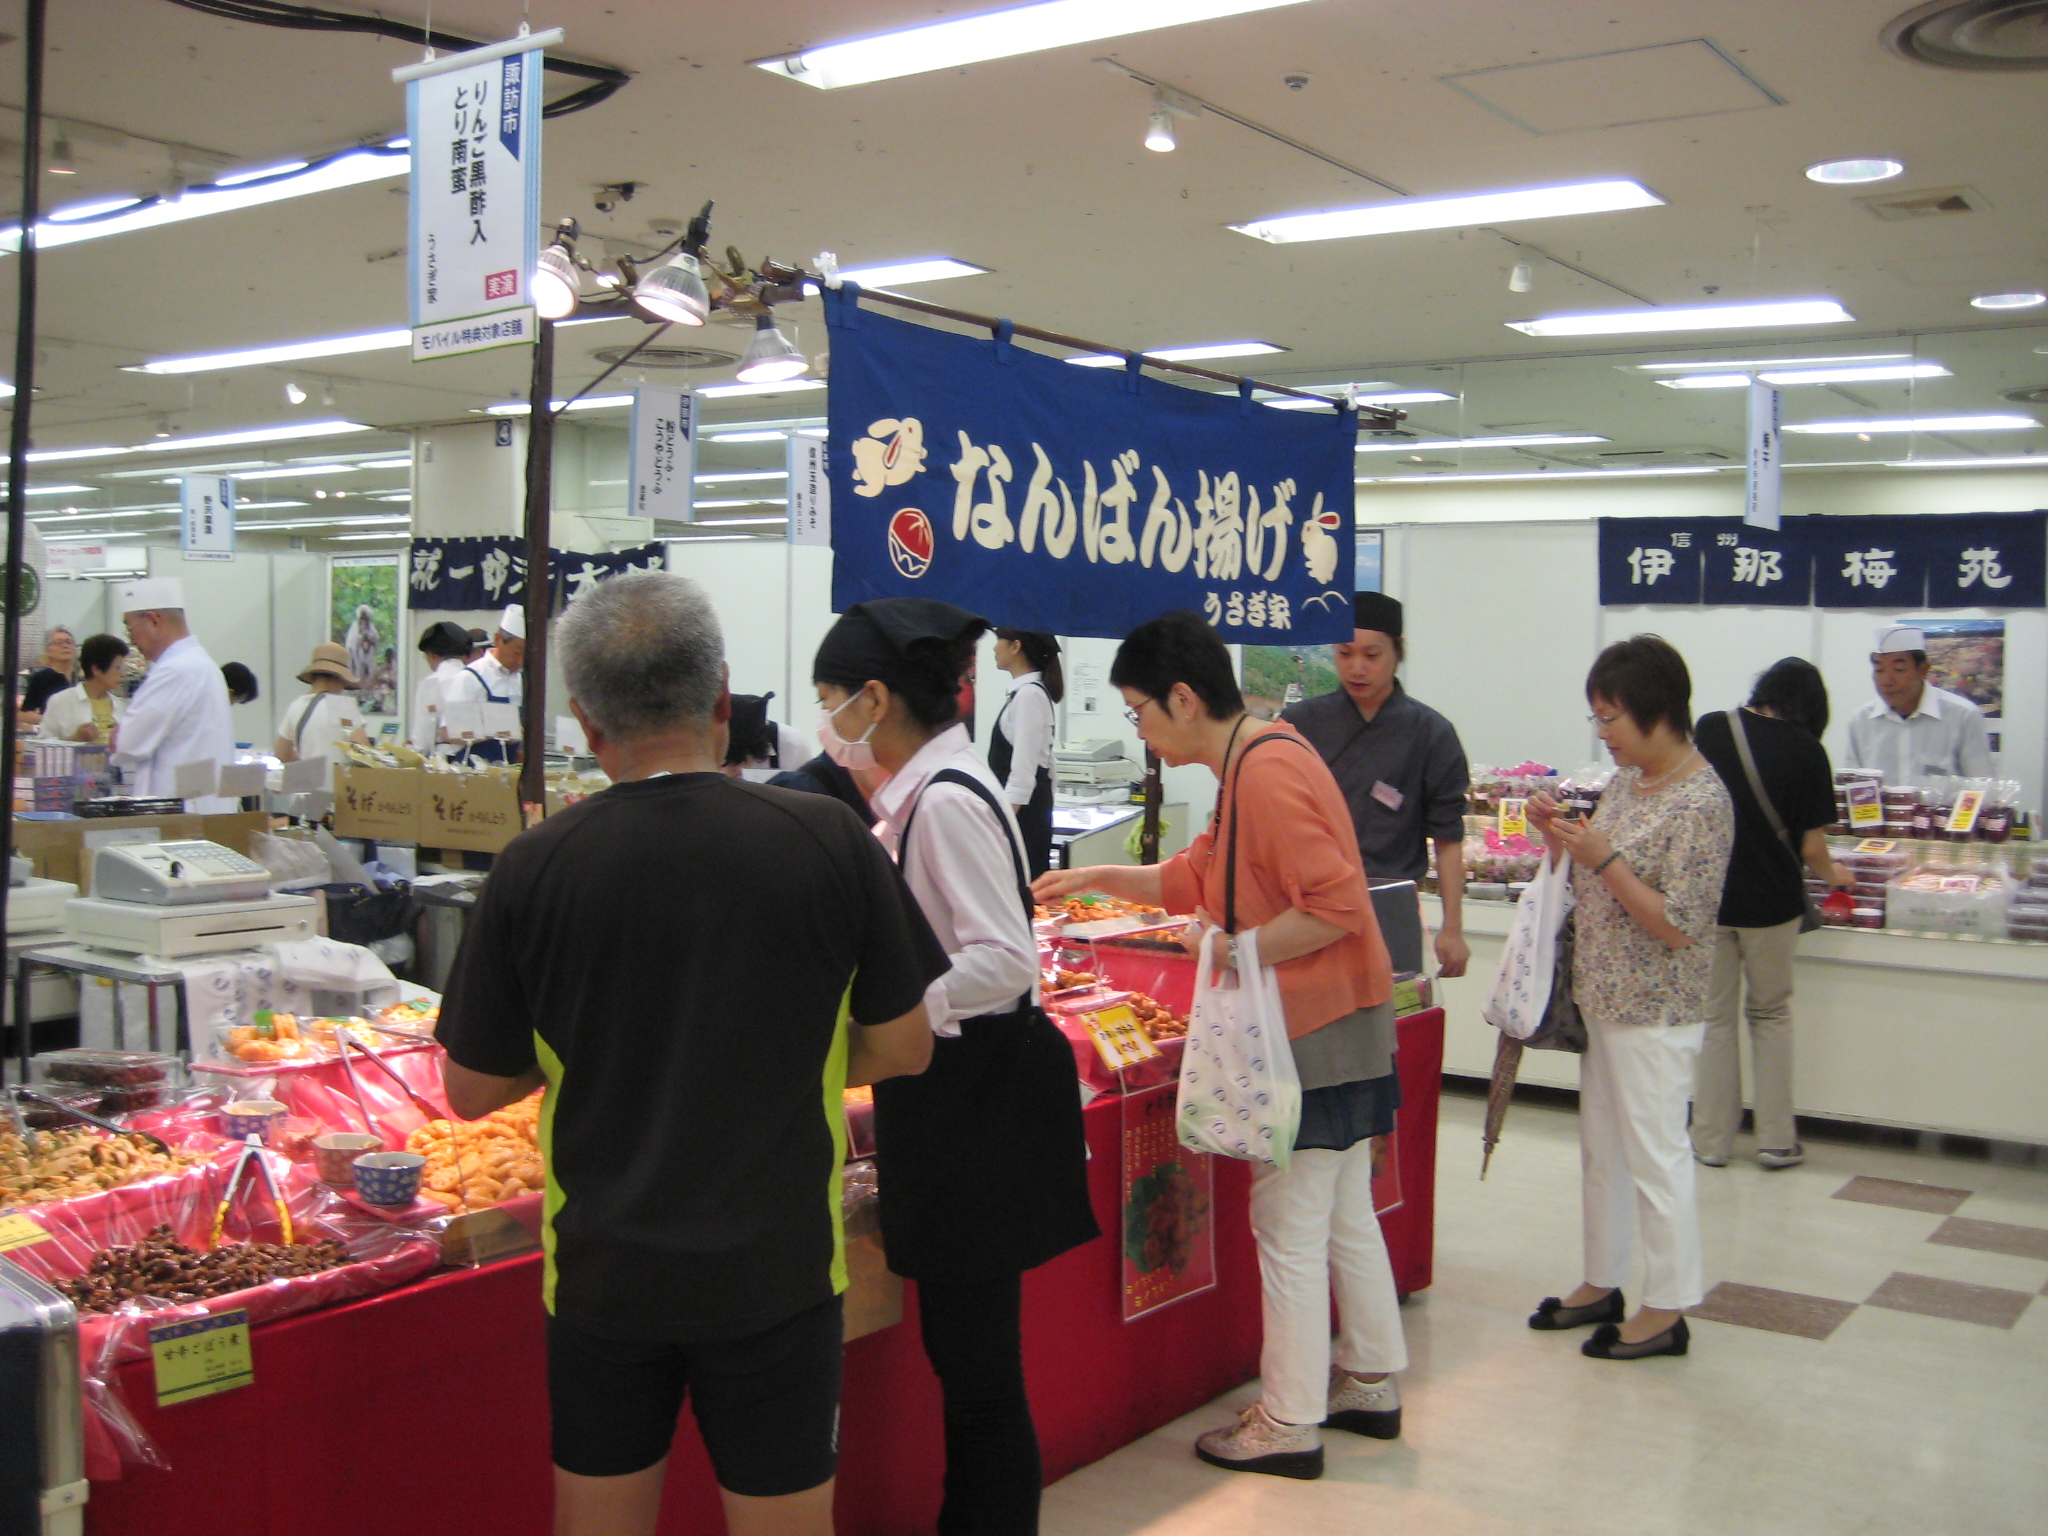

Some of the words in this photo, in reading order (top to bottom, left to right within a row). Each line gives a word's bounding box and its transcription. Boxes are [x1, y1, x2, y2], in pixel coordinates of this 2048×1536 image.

[451, 85, 468, 195] とり南蛮
[469, 79, 488, 246] りんご黒酢入
[949, 430, 1297, 582] なんばん揚げ
[1670, 531, 1739, 549] 信州
[1627, 546, 2013, 589] 伊那梅苑
[1203, 590, 1292, 631] うさぎ家
